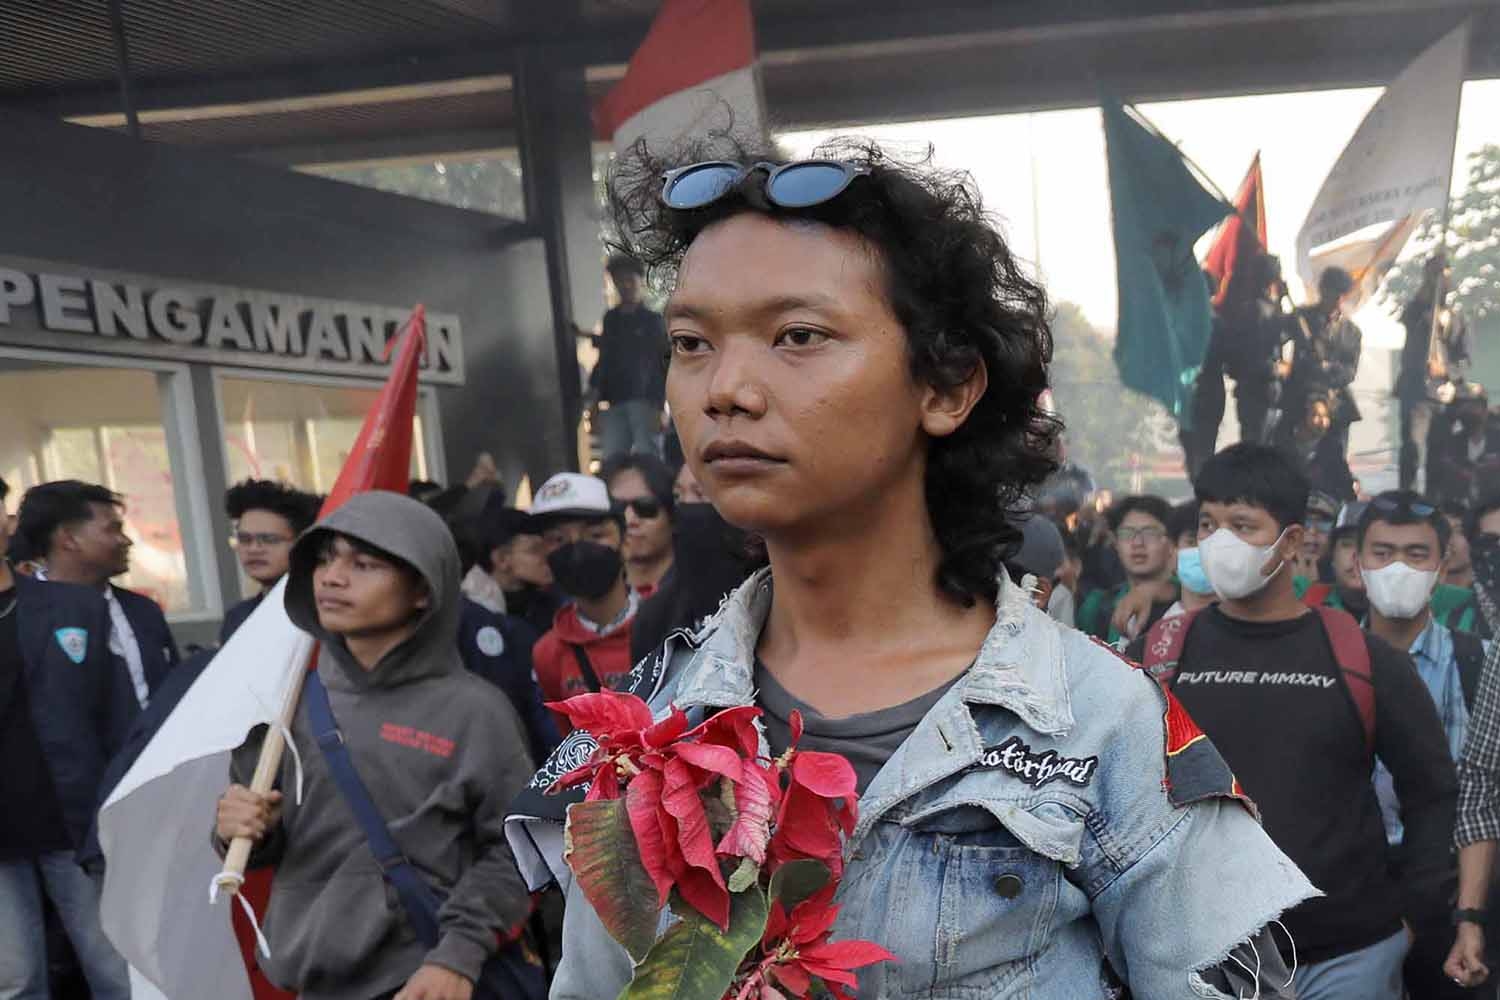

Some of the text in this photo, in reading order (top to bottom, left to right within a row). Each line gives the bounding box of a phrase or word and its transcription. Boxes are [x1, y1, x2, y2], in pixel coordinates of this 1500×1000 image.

[1177, 670, 1336, 688] FUTURE MMXXV
[981, 743, 1094, 786] otörhead
